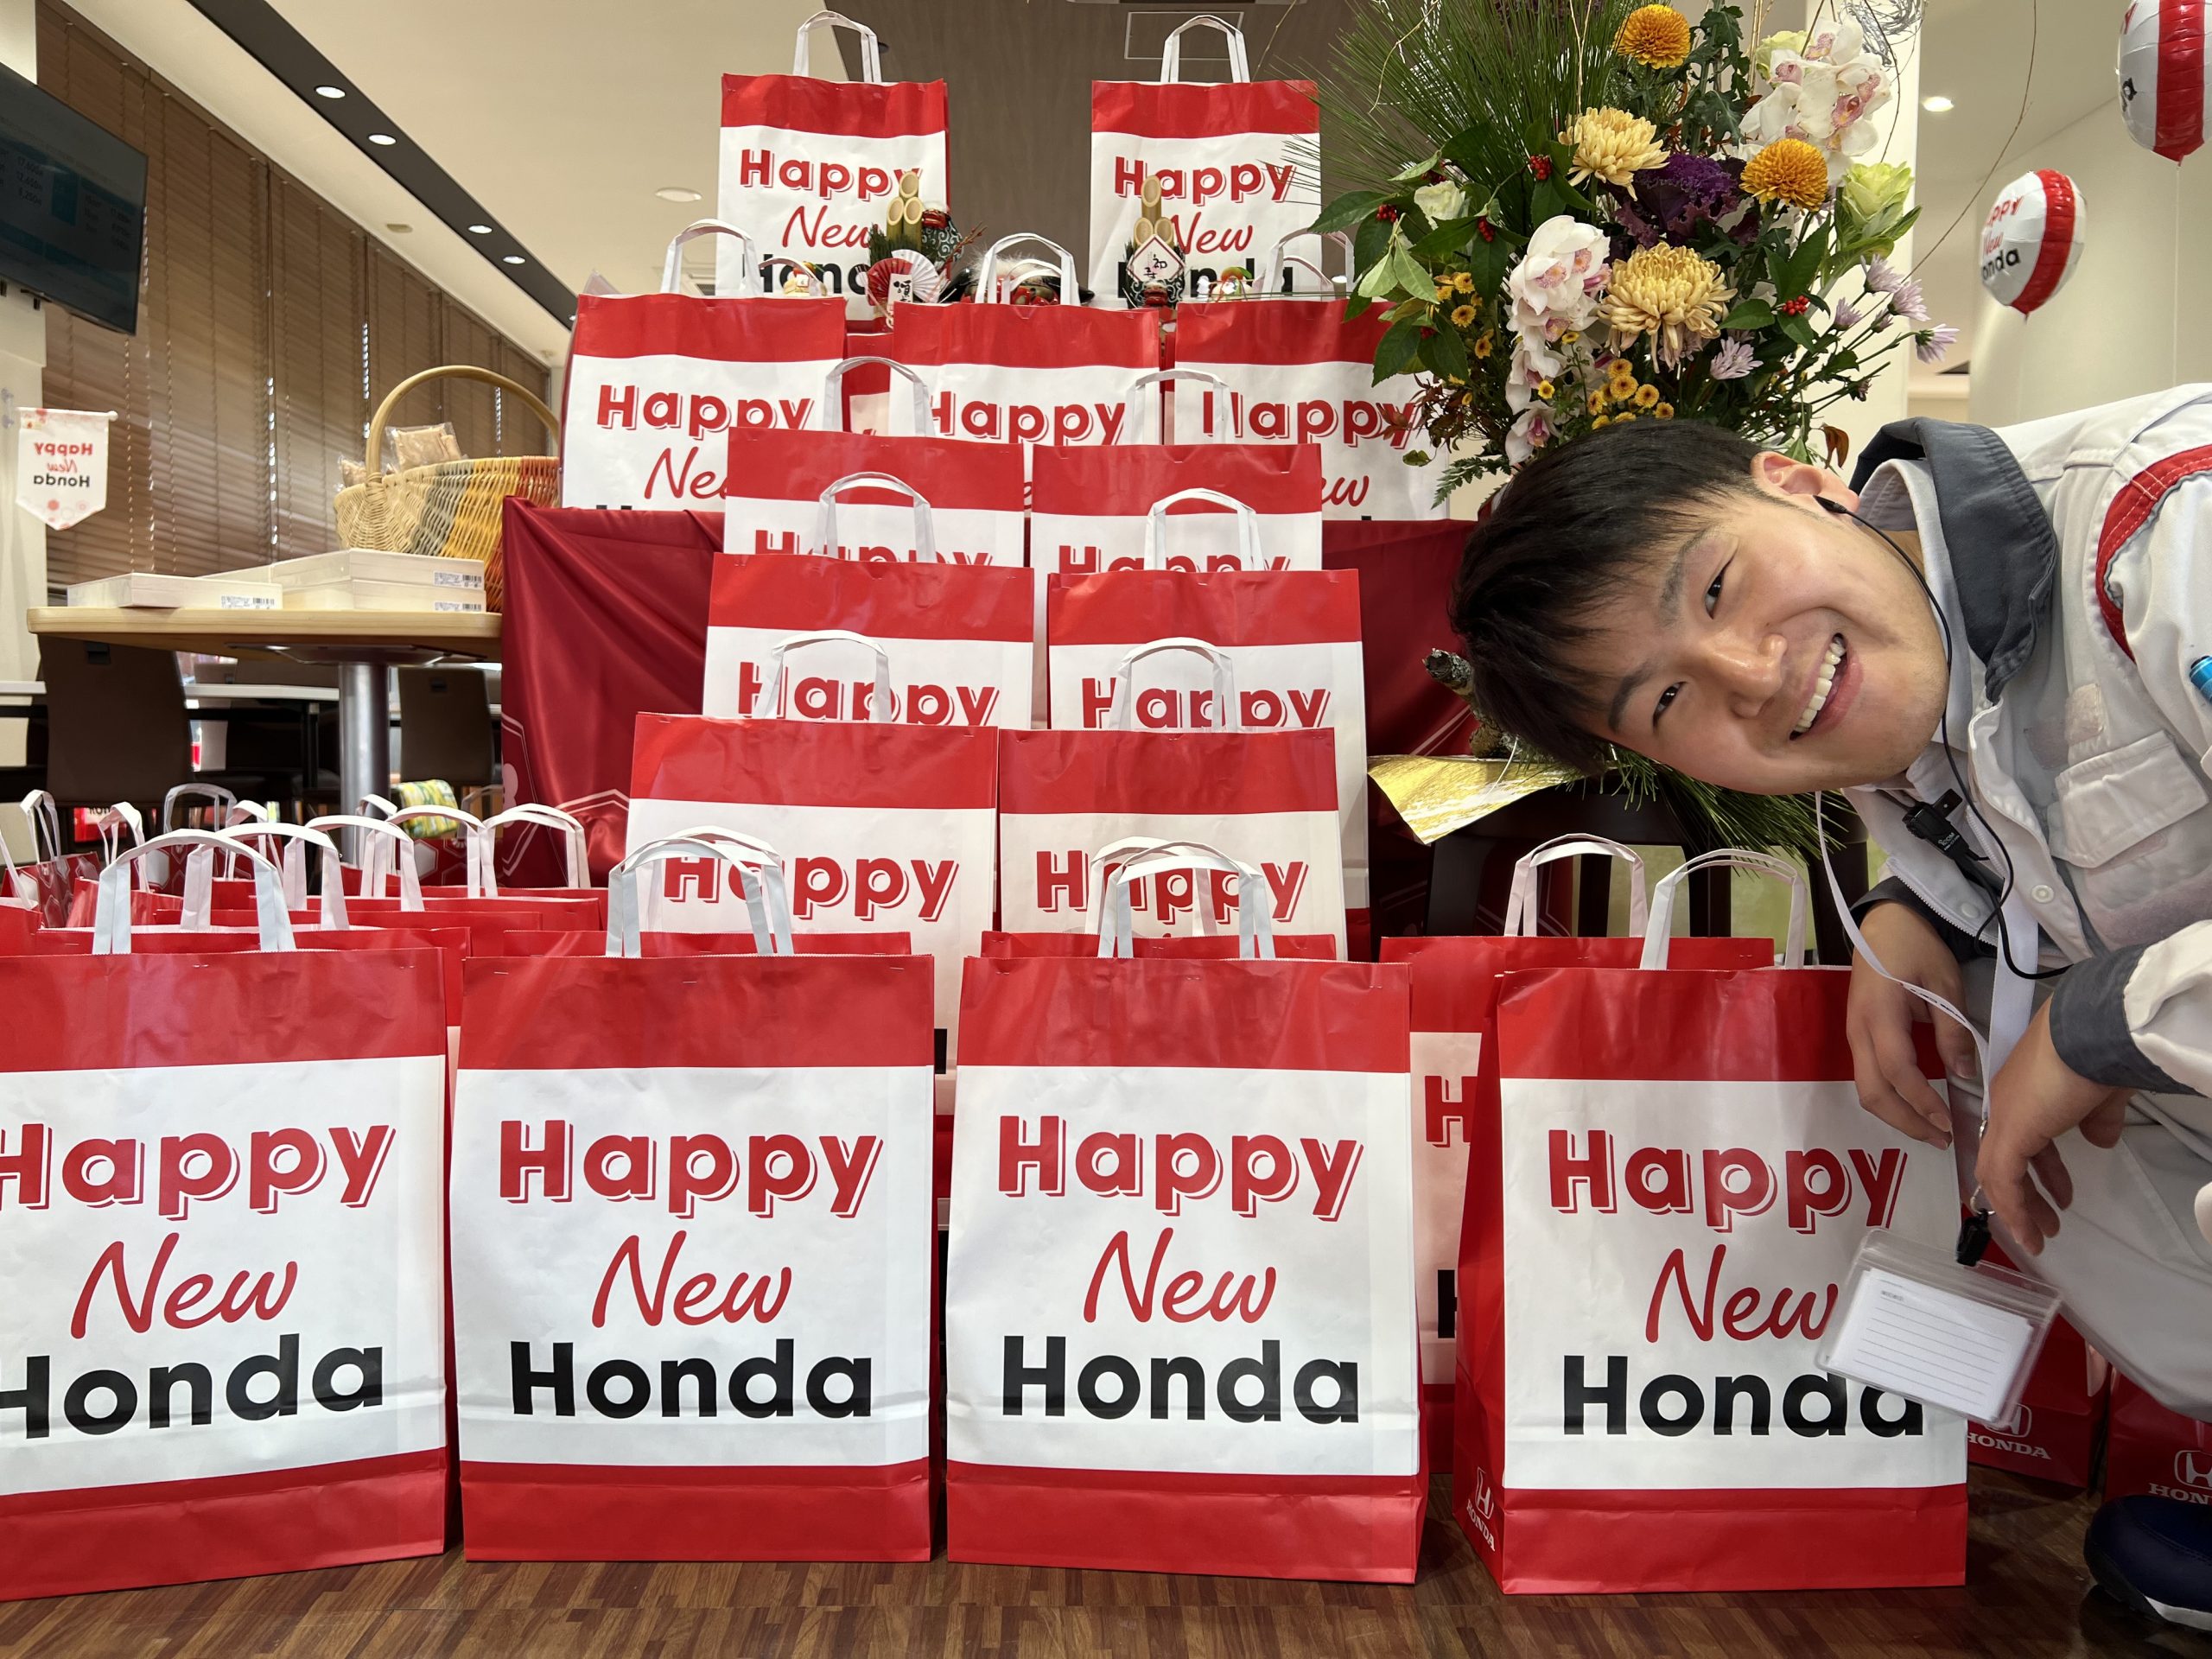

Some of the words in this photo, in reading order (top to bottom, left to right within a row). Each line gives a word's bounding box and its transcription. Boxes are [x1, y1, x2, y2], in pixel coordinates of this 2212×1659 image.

[740, 149, 922, 201] Happ
[1115, 156, 1297, 207] Happy
[1986, 195, 2024, 228] ppy
[1982, 248, 2021, 281] onda
[597, 385, 815, 441] Happy
[644, 446, 727, 500] Ne
[0, 1123, 396, 1222] Happy
[499, 1119, 884, 1219] Happy
[999, 1115, 1364, 1223] Happy
[1548, 1129, 1908, 1235] Happy
[70, 1232, 298, 1339] New
[592, 1230, 792, 1329] New
[1083, 1227, 1276, 1324] New
[1645, 1243, 1839, 1344] New
[0, 1333, 383, 1440] Honda
[510, 1338, 872, 1419] Honda
[1002, 1335, 1359, 1425] Honda
[1563, 1355, 1923, 1439] Honda
[1466, 1498, 1496, 1552] HONDA
[2148, 1482, 2212, 1505] HON
